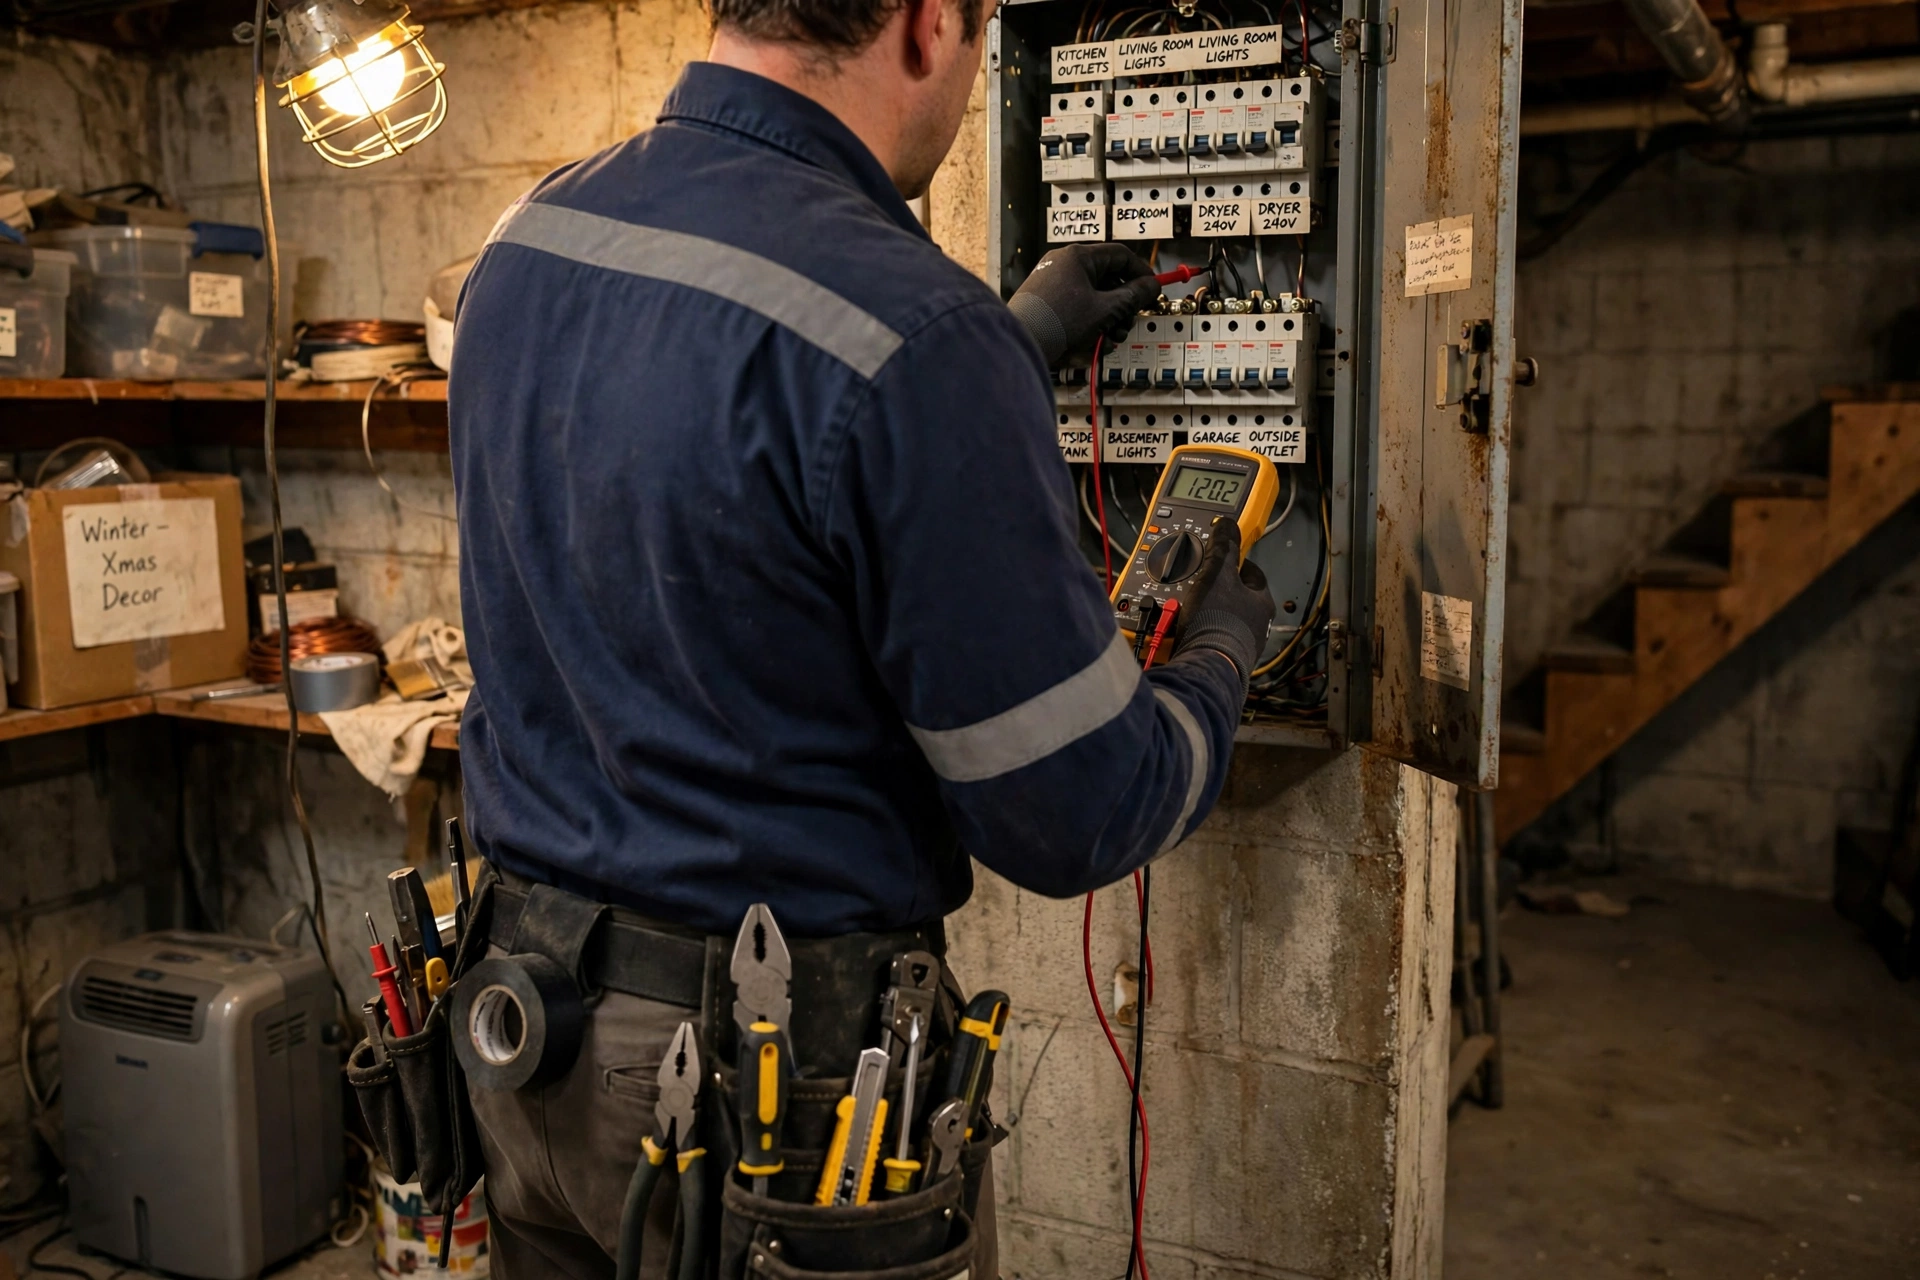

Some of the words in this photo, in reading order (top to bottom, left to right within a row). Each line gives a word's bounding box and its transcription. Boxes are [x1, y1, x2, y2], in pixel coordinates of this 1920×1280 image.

[1198, 34, 1239, 49] LIVING
[1243, 30, 1277, 45] ROOM
[1118, 41, 1158, 56] LIVING
[1162, 38, 1194, 51] ROOM
[1057, 47, 1107, 62] KITCHEN
[1206, 48, 1250, 63] LIGHTS
[1058, 61, 1110, 76] OUTLETS
[1124, 55, 1166, 70] LIGHTS
[1116, 207, 1169, 220] BEDROOM
[1198, 204, 1240, 217] DRYER
[1258, 201, 1302, 215] DRYER
[1052, 209, 1097, 222] KITCHEN
[1053, 223, 1100, 236] OUTLETS
[1138, 222, 1146, 234] S
[1203, 219, 1237, 232] 240V
[1262, 217, 1297, 230] 240V
[1108, 432, 1169, 444] BASEMENT
[1192, 431, 1241, 443] GARAGE
[1248, 430, 1301, 442] OUTSIDE
[1116, 446, 1157, 458] LIGHTS
[1250, 445, 1299, 457] OUTLET
[81, 516, 149, 543] Winter
[102, 550, 158, 576] Xmas
[102, 582, 164, 611] Decor
